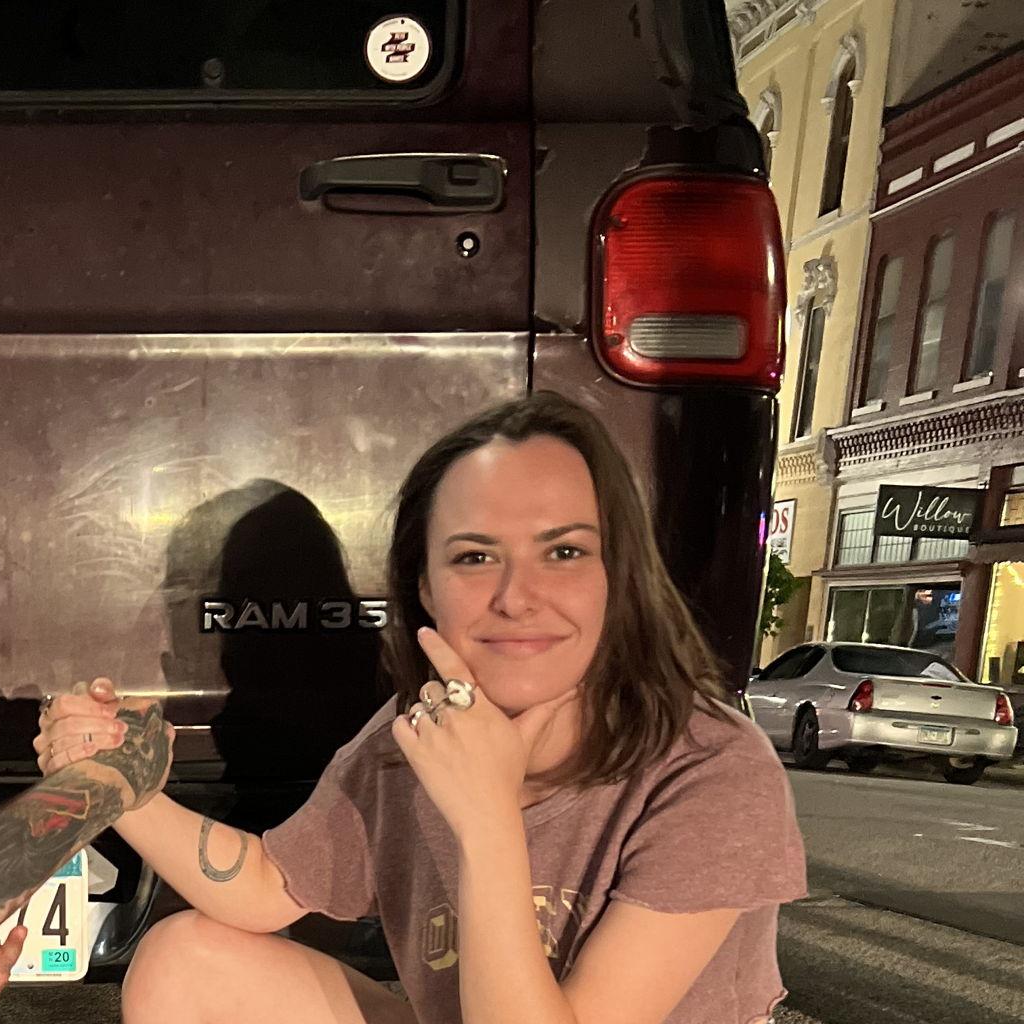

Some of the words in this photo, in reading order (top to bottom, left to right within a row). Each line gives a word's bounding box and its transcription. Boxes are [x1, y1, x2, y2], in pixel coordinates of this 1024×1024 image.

[881, 490, 973, 532] Willow
[913, 523, 970, 534] BOUTIQUE
[203, 598, 308, 630] RAM
[320, 599, 389, 630] 35
[54, 951, 70, 963] 20
